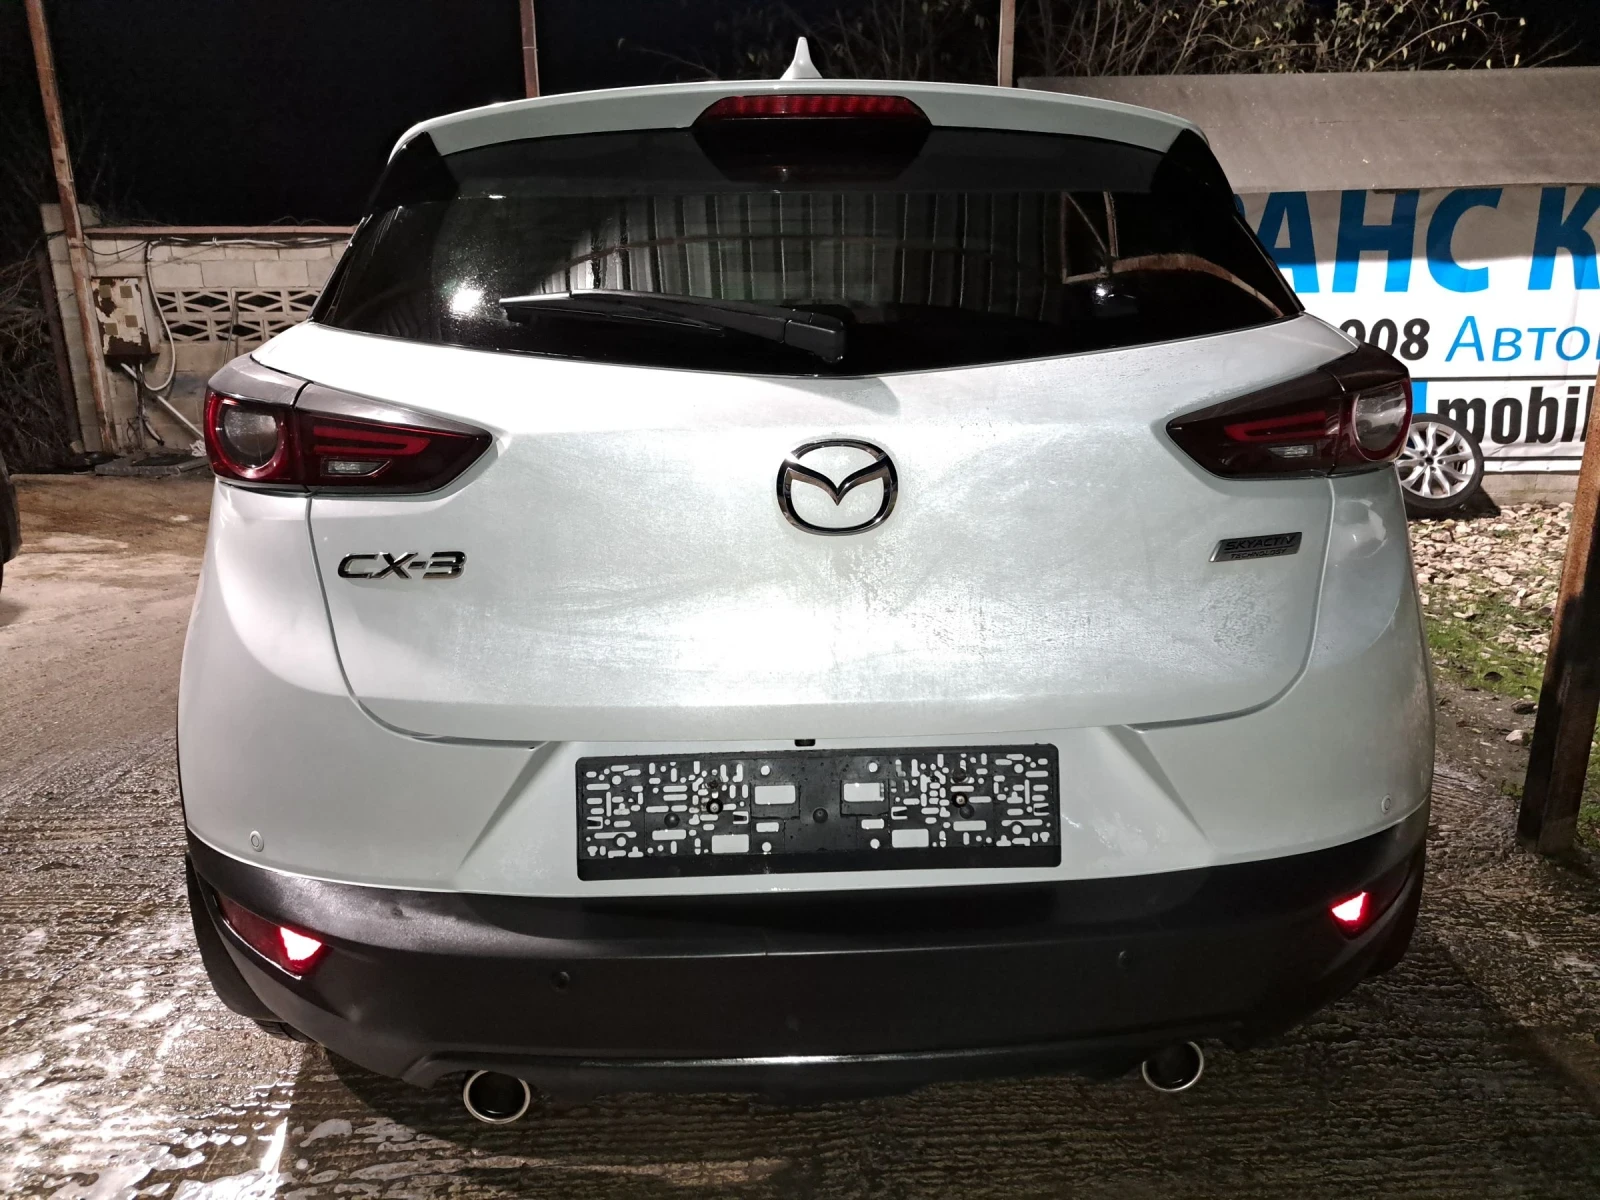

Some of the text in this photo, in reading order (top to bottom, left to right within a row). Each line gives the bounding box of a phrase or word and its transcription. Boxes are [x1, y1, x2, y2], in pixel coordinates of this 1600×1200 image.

[1234, 187, 1503, 293] АНС
[1444, 315, 1600, 362] Авто
[1224, 535, 1296, 551] SKYACTIV
[337, 550, 467, 580] CX-3
